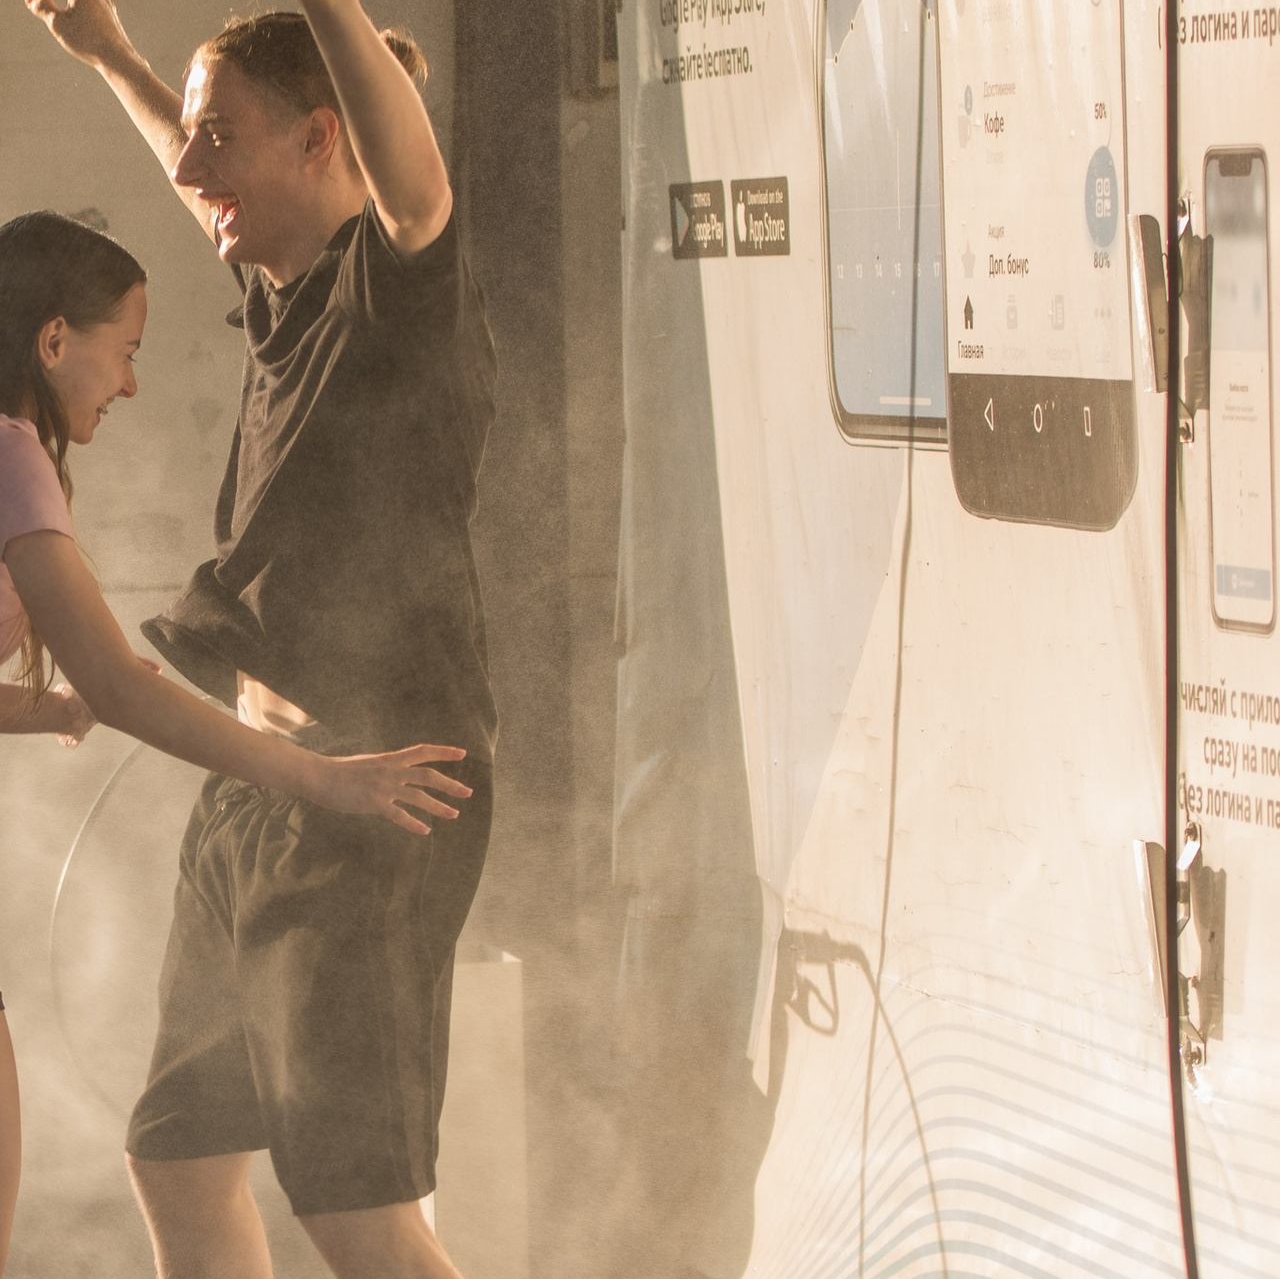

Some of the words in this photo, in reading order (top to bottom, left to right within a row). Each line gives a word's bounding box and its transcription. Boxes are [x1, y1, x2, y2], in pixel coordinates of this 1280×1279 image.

[1190, 11, 1238, 44] логина
[1241, 10, 1250, 39] и
[984, 110, 1005, 138] Кофе
[749, 212, 765, 250] App
[764, 211, 786, 242] Store
[989, 254, 1005, 278] Доп.
[1007, 252, 1029, 278] бонус
[1093, 251, 1111, 269] 80%
[957, 340, 984, 359] Главная
[1230, 689, 1238, 719] с
[1203, 735, 1239, 779] сразу
[1242, 742, 1258, 773] на
[1206, 786, 1252, 823] логина
[1255, 796, 1263, 827] и
